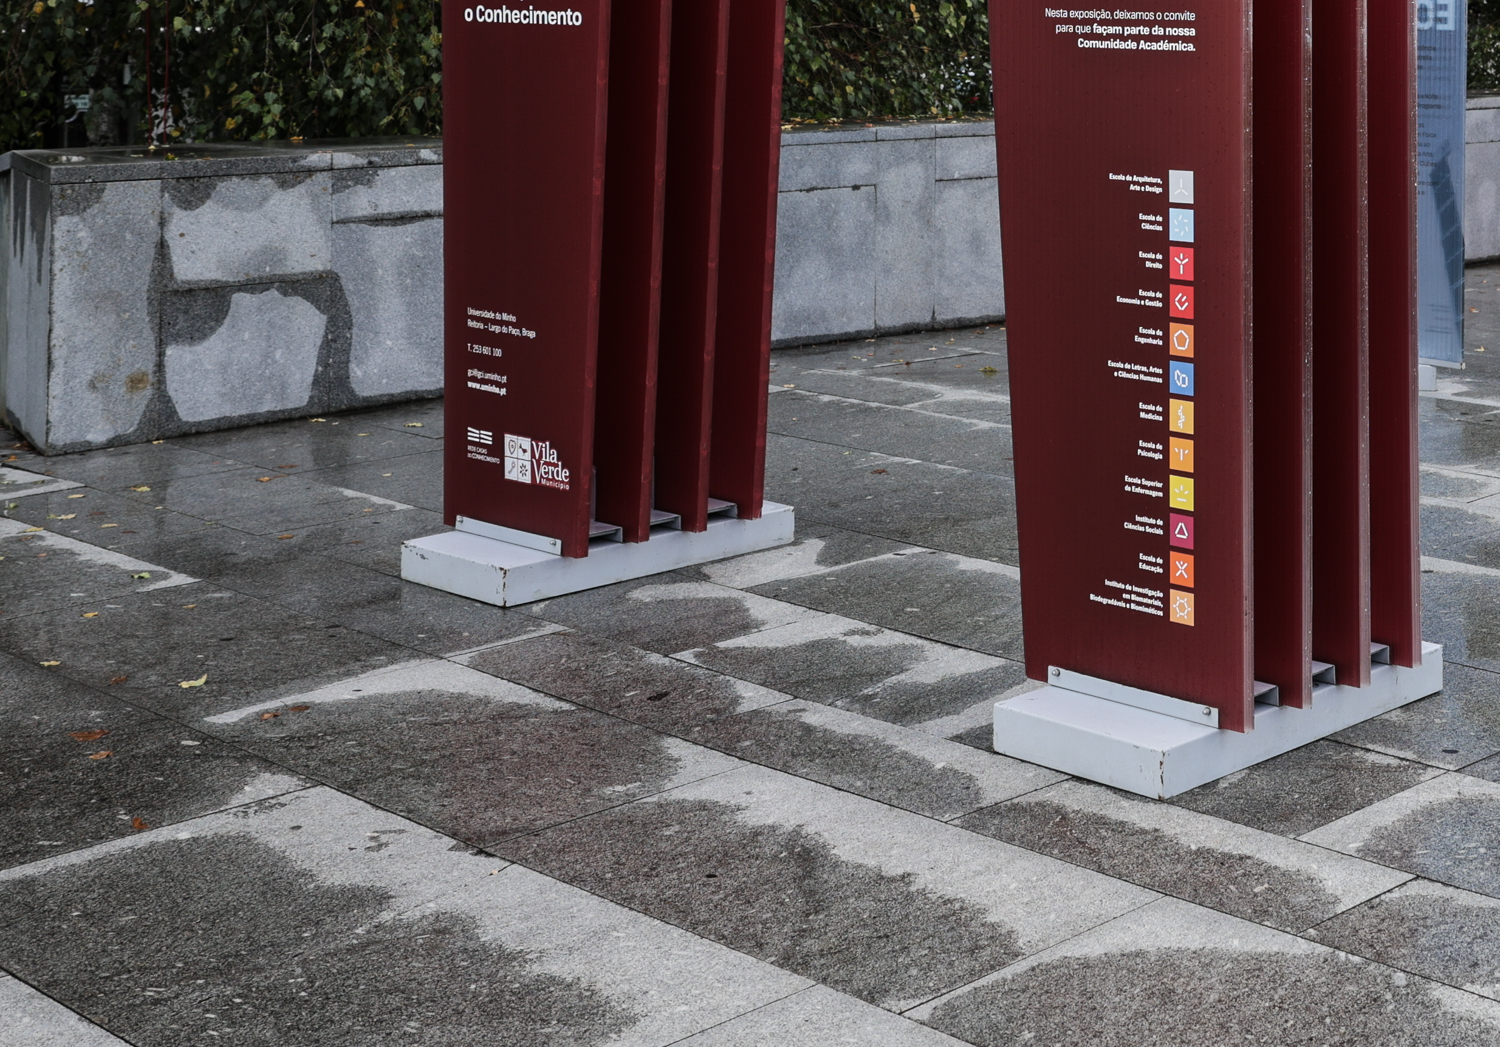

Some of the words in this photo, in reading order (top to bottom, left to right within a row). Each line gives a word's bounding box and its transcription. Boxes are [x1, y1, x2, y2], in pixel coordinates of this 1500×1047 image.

[464, 8, 473, 22] o
[476, 5, 582, 26] Conhecimento
[1045, 8, 1068, 18] Nesta
[1069, 9, 1112, 21] exposição,
[1114, 9, 1155, 20] deixamos
[1156, 12, 1162, 20] o
[1164, 10, 1196, 21] convite
[1056, 24, 1073, 34] para
[1075, 25, 1091, 35] que
[1093, 24, 1123, 36] façam
[1124, 25, 1150, 37] parte
[1152, 25, 1164, 36] da
[1166, 27, 1196, 36] nossa
[1078, 38, 1137, 50] Comunidade
[1138, 40, 1196, 52] Académica.
[532, 441, 557, 463] Vila
[532, 459, 569, 484] Verde
